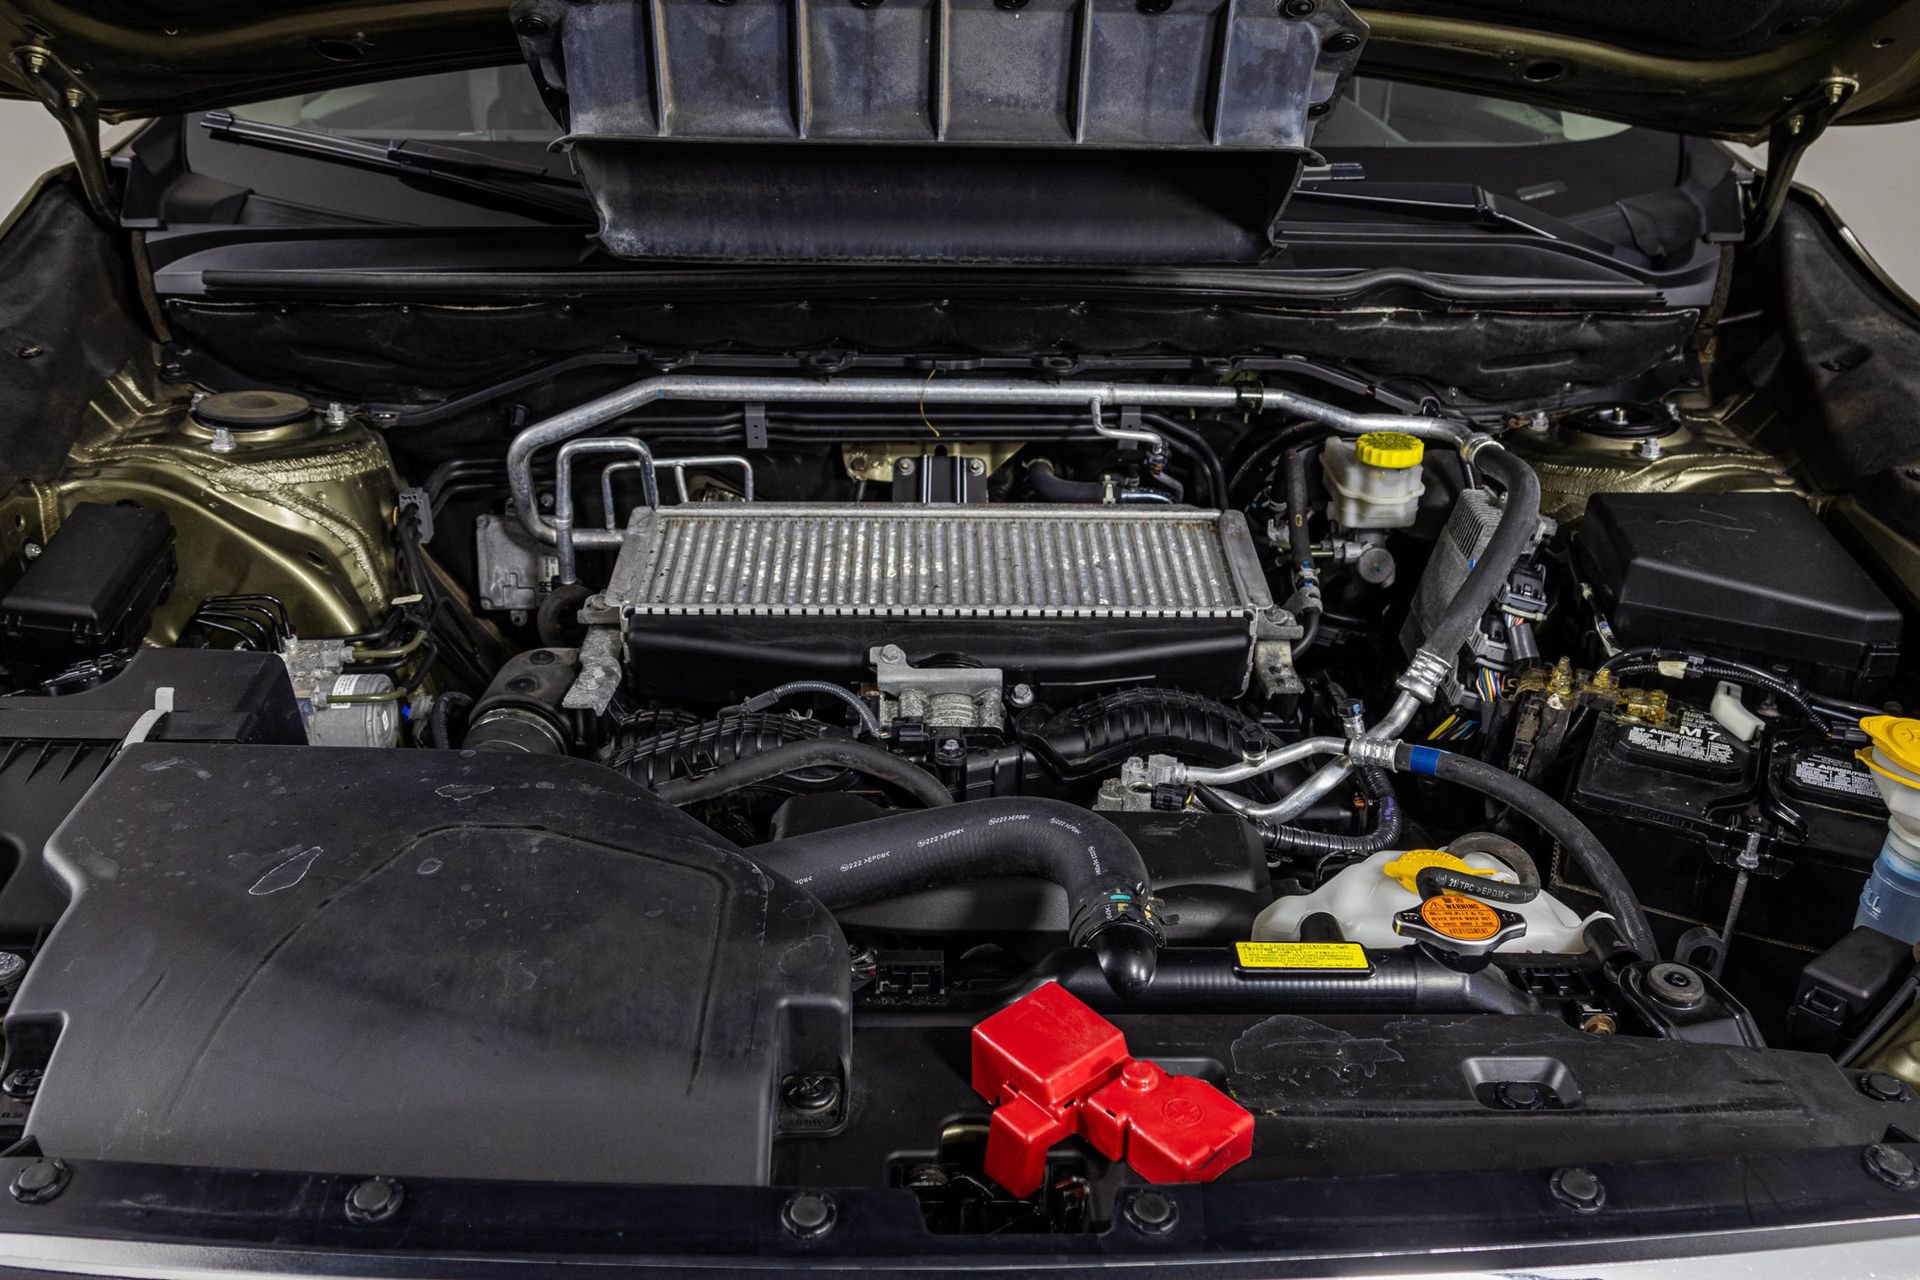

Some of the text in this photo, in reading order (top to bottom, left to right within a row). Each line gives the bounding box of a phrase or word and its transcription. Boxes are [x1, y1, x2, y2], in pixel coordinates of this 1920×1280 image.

[1826, 765, 1873, 779] DANGER/POISO
[924, 835, 939, 845] 222
[848, 859, 863, 869] 222
[1460, 881, 1475, 892] TPC
